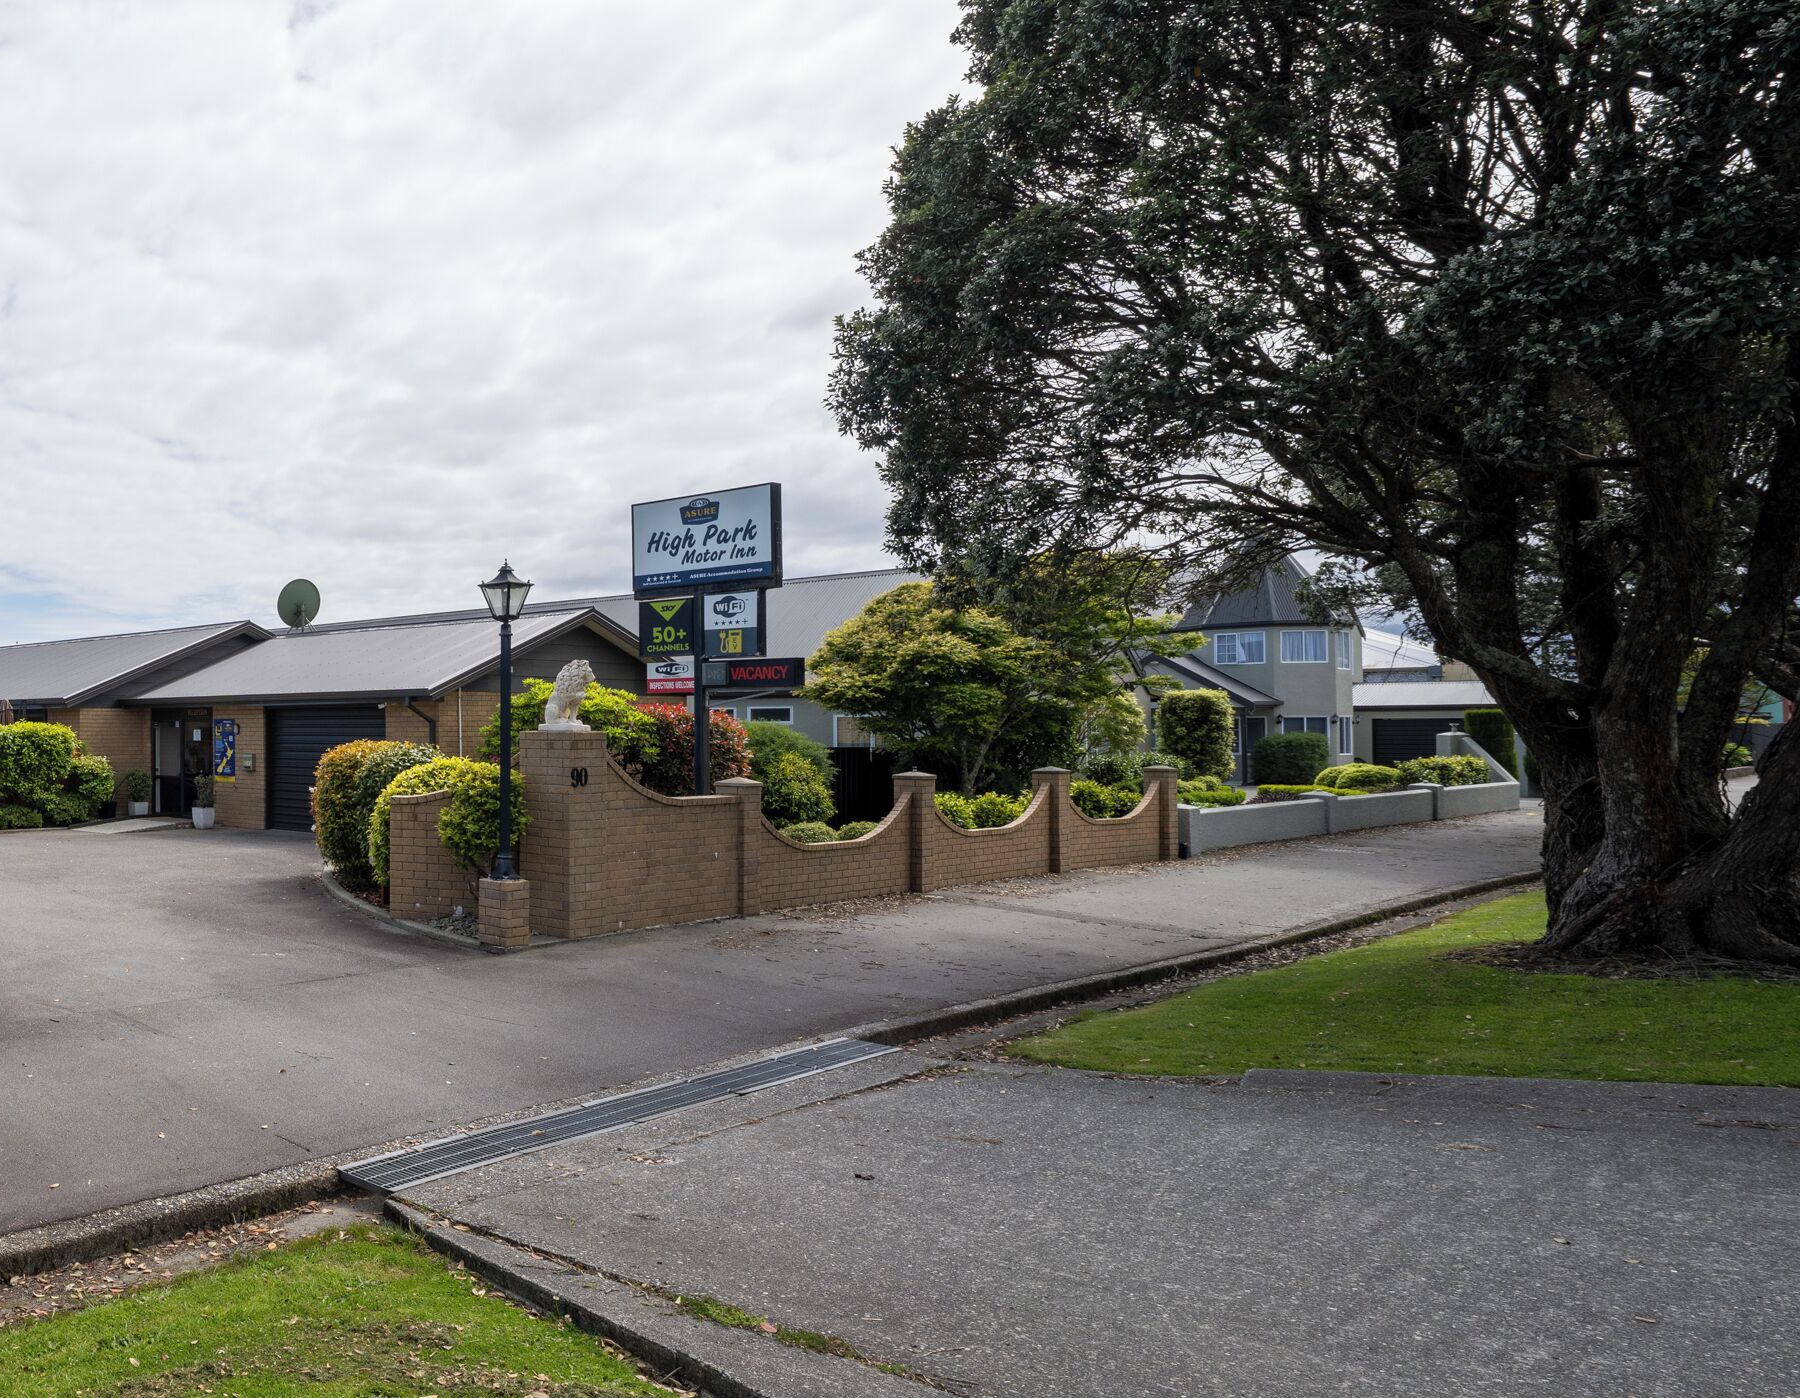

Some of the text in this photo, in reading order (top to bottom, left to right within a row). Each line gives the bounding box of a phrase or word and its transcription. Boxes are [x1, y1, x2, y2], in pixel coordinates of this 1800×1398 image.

[685, 506, 717, 518] ASURE
[647, 518, 758, 557] High Park
[681, 543, 757, 565] Motor Inn
[652, 626, 687, 643] 50+
[647, 643, 690, 652] CHANNELS
[730, 665, 788, 680] VACANCY
[649, 680, 695, 690] INSPECTIONS WELCOME
[571, 767, 588, 787] 90
